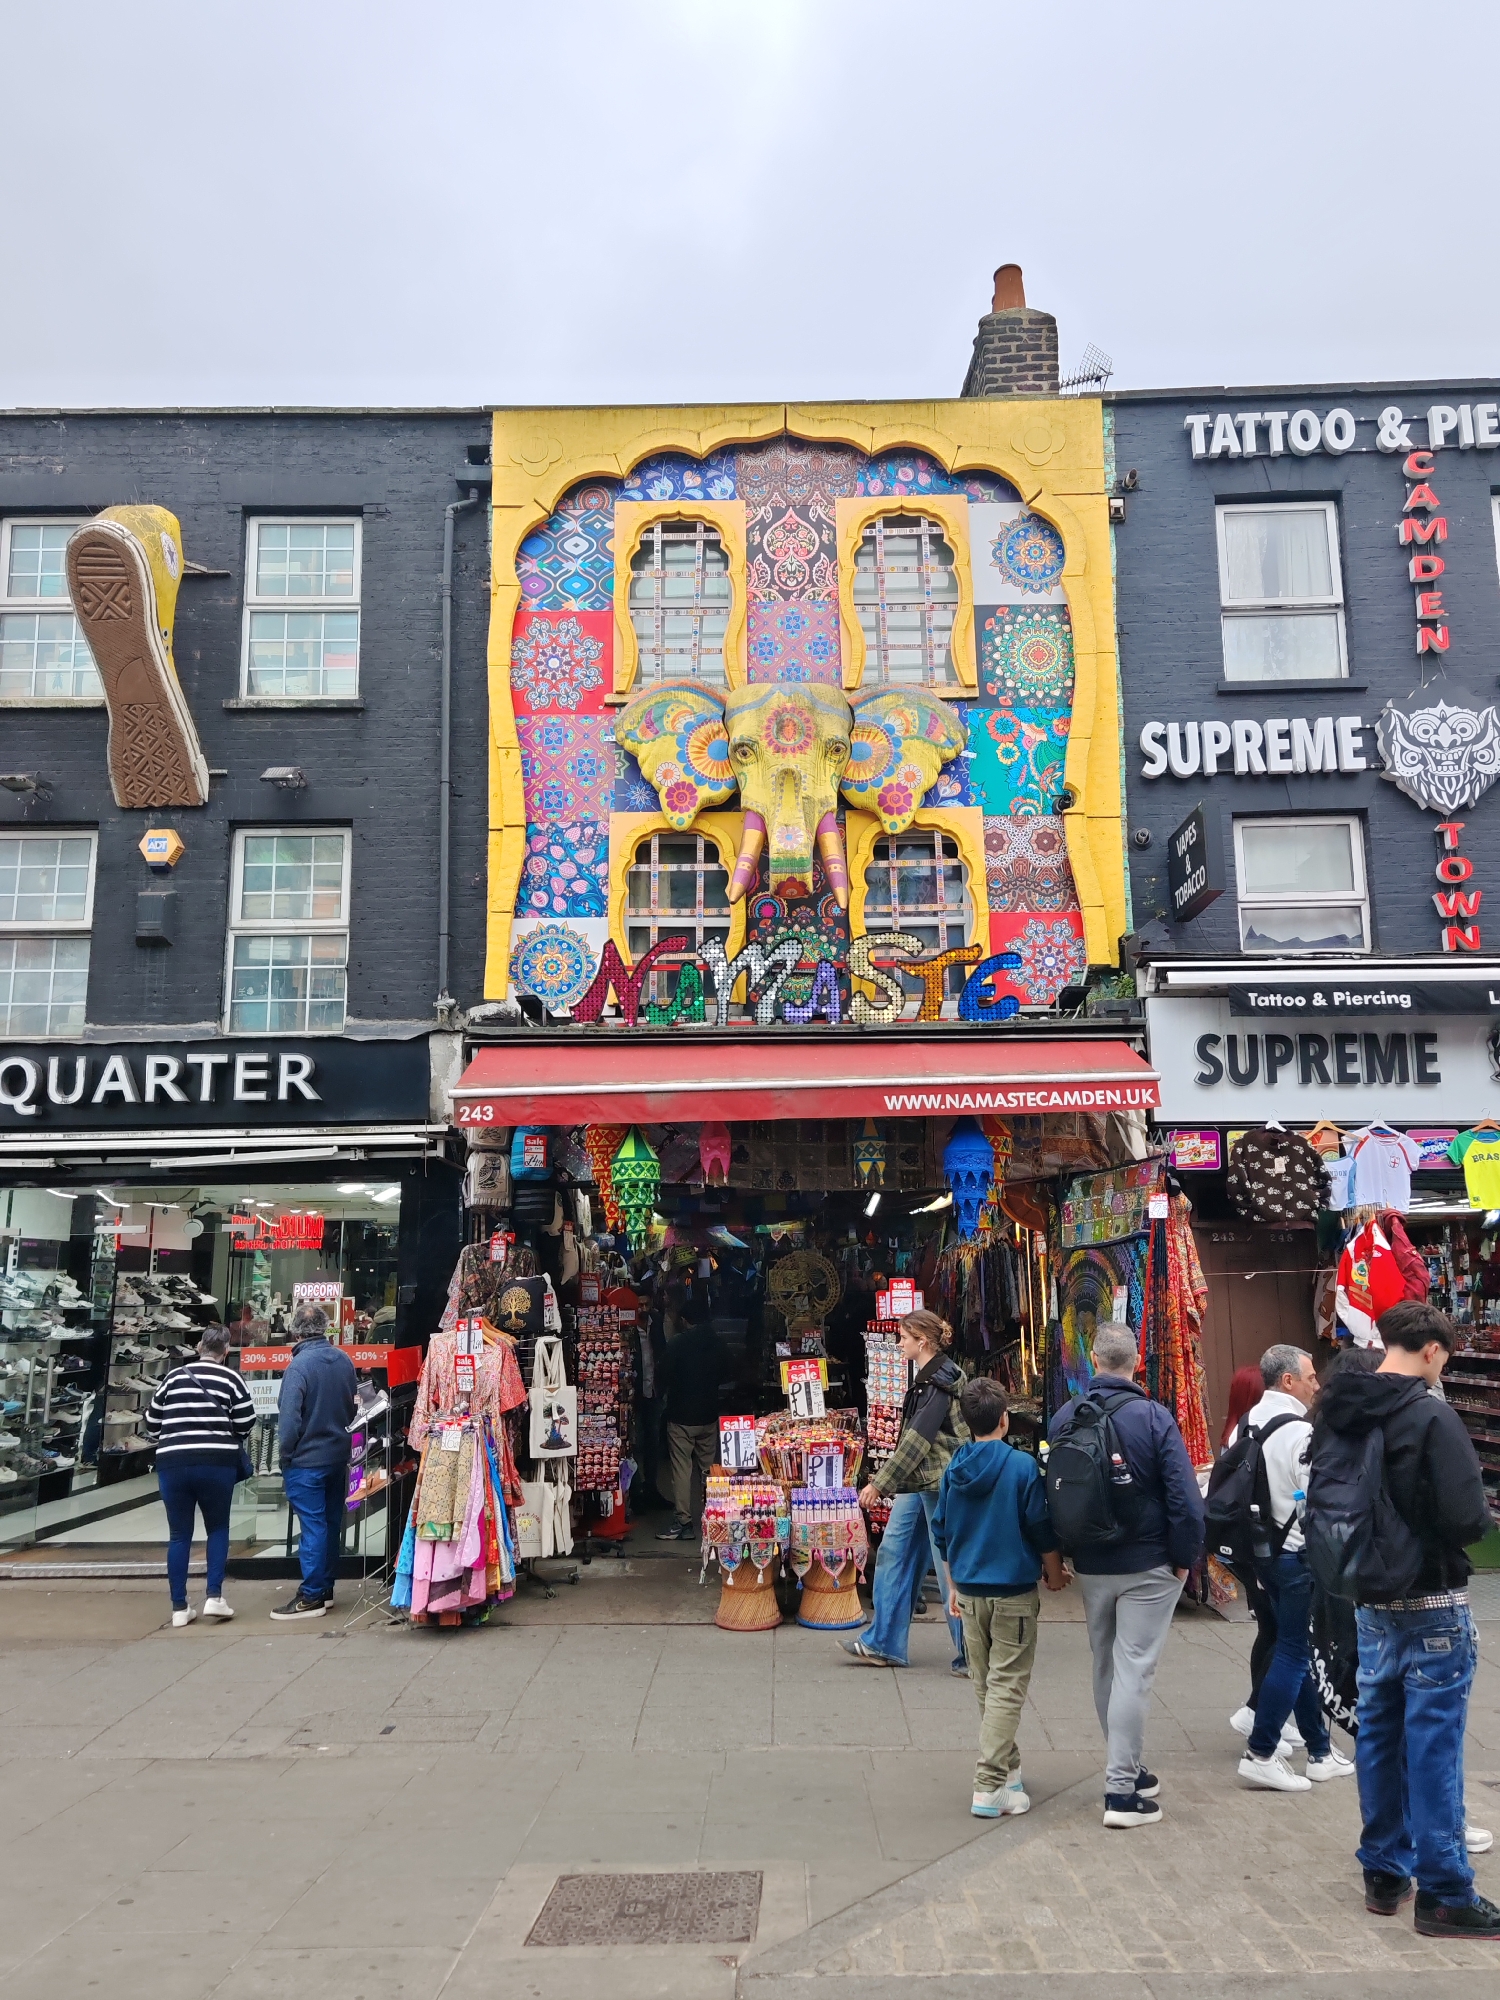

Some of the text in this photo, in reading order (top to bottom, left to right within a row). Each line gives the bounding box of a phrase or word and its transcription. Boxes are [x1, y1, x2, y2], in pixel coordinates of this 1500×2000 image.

[1183, 408, 1356, 459] TATTOO
[1375, 406, 1413, 453] &
[1399, 451, 1449, 654] CAMDEN
[1139, 716, 1367, 779] SUPREME
[147, 839, 168, 851] ADT
[1176, 821, 1197, 858] VAPES
[1185, 853, 1191, 875] &
[1174, 865, 1206, 910] TOBACCO
[1432, 822, 1482, 952] TOWN
[569, 931, 1023, 1028] NAMASTE
[1248, 990, 1412, 1008] Tattoo & Piercing
[1193, 1032, 1442, 1087] SUPREME
[0, 1052, 323, 1116] QUARTER
[883, 1088, 1156, 1110] WWW.NAMASTECAMDEN.UK
[459, 1105, 494, 1121] 243
[526, 1137, 544, 1145] sale
[1472, 1152, 1500, 1163] BRAS
[1212, 1232, 1235, 1242] 243
[293, 1282, 341, 1298] POPCORN
[892, 1280, 912, 1289] sale
[878, 1296, 887, 1320] sale
[804, 1330, 821, 1338] sale
[240, 1353, 267, 1364] -30%
[268, 1352, 294, 1363] -50%
[352, 1351, 378, 1361] -50%
[456, 1355, 472, 1365] sale
[791, 1369, 818, 1383] sale
[252, 1385, 273, 1395] STAFF
[722, 1417, 751, 1431] sale
[812, 1444, 840, 1455] sale
